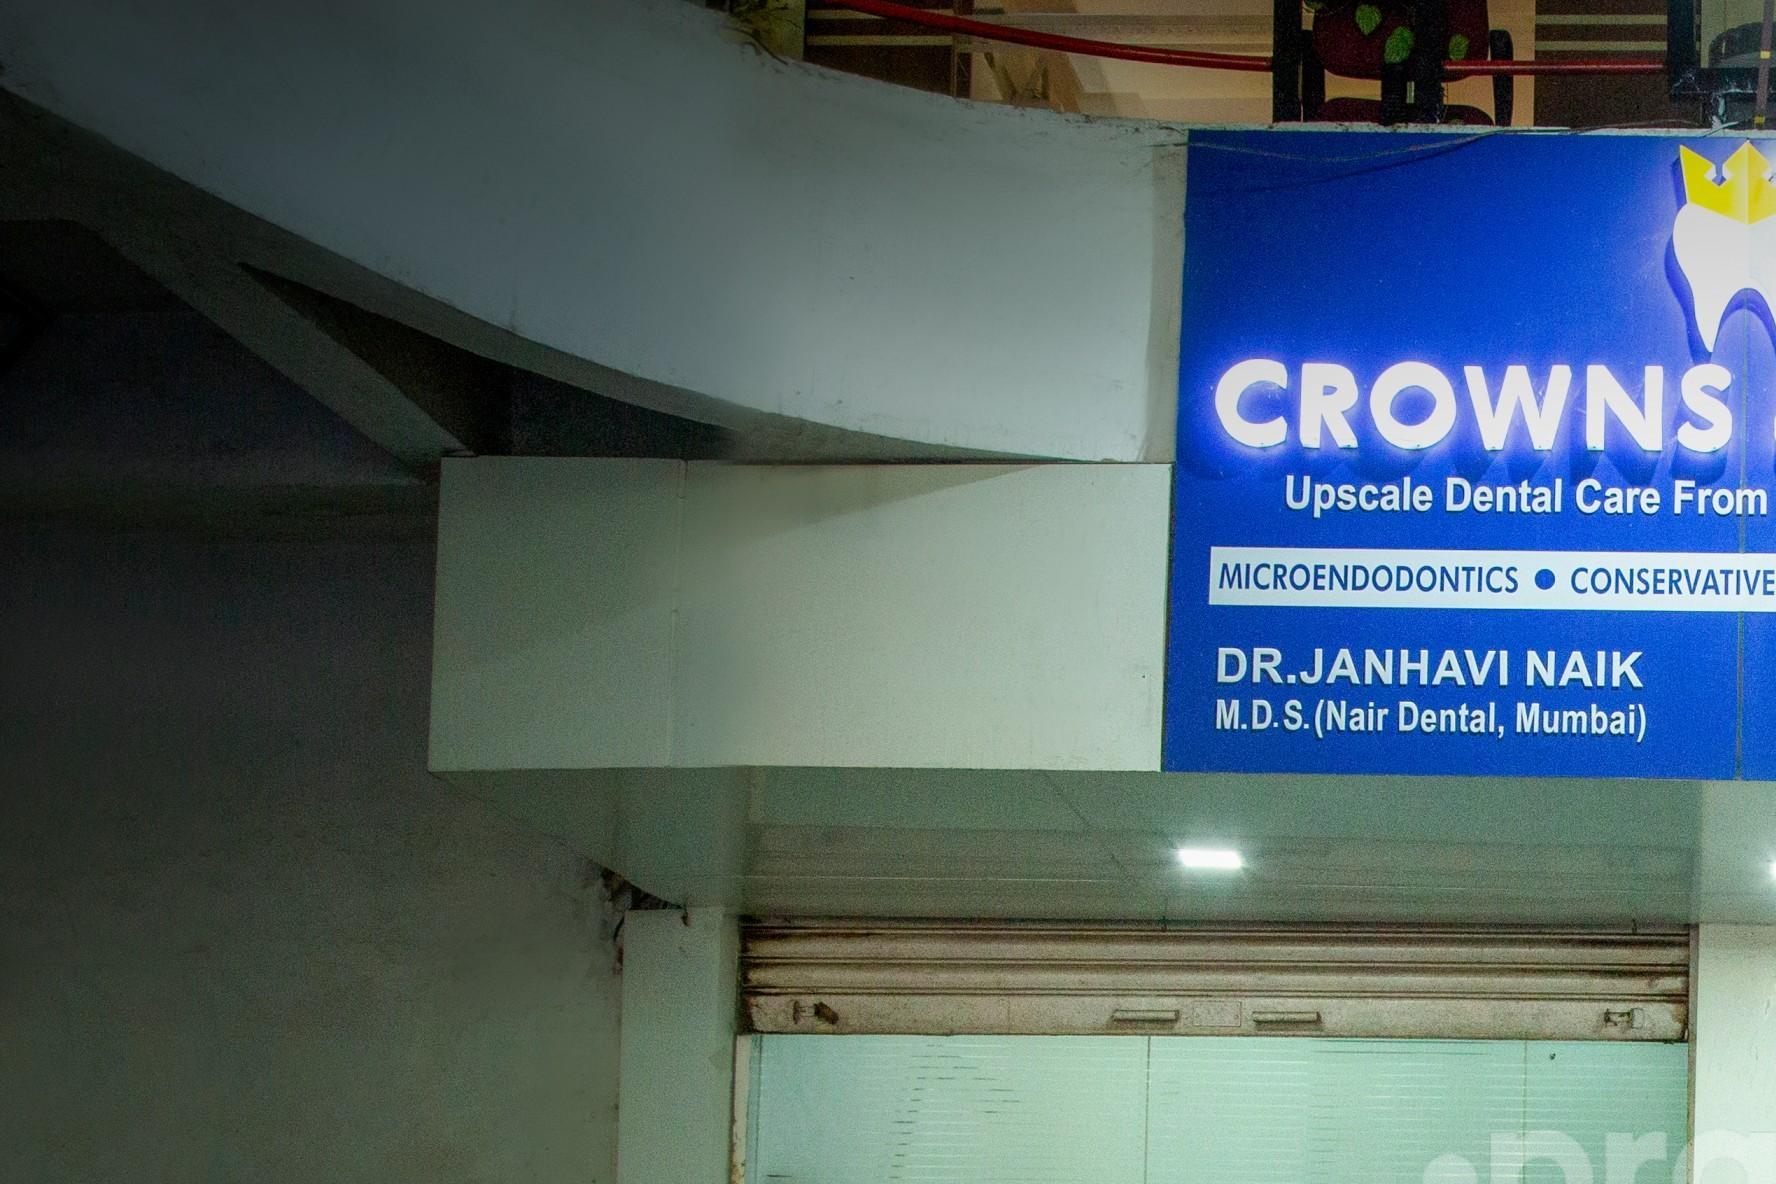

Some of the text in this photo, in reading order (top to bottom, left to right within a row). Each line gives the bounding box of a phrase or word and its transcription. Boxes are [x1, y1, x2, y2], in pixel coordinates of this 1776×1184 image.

[1214, 358, 1734, 453] CROWNS
[1285, 474, 1433, 518] Upscale
[1445, 476, 1562, 513] Dental
[1575, 479, 1660, 514] Care
[1673, 479, 1767, 517] From
[1218, 562, 1519, 594] MICROENDODONTICS
[1570, 566, 1775, 597] CONSERVATIVE
[1216, 647, 1644, 688] DR.JANHAVI NAIK
[1398, 702, 1505, 740] Dental,
[1515, 702, 1647, 743] Mumbai)
